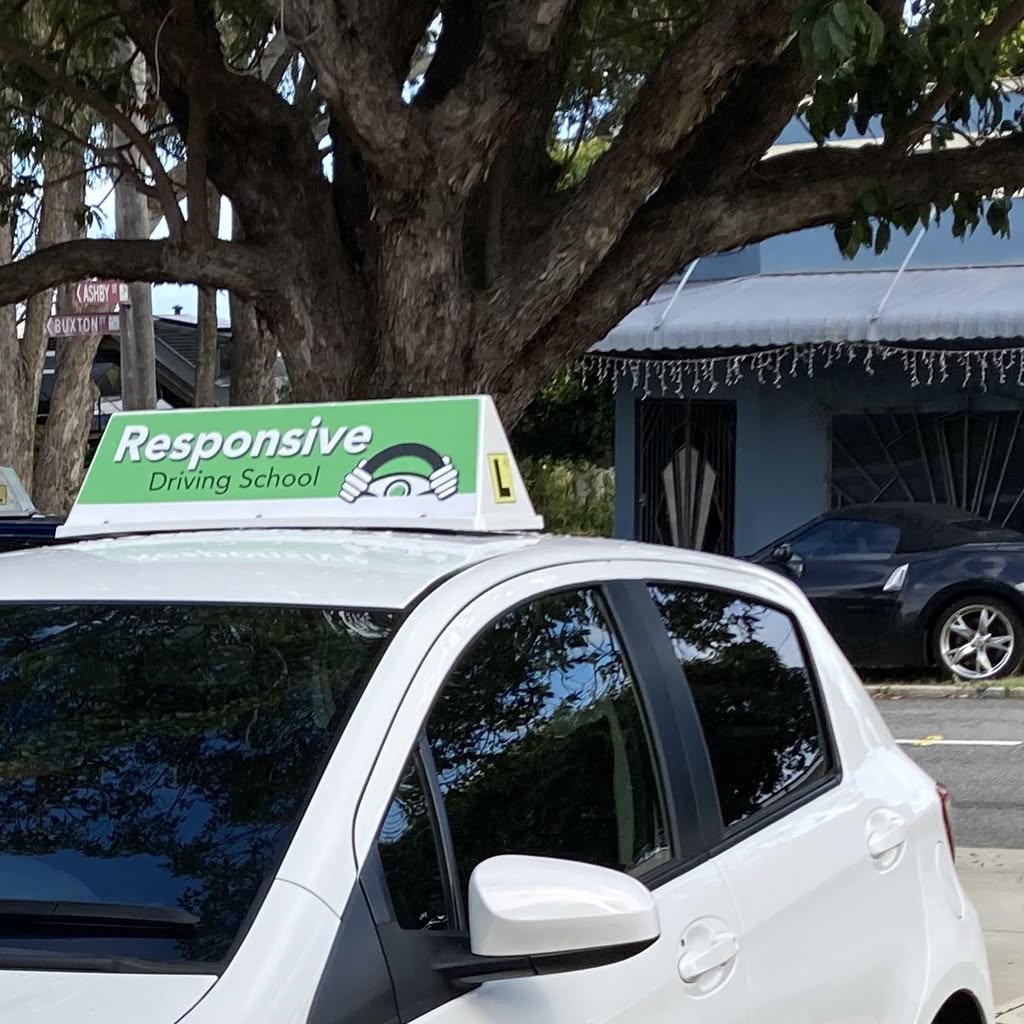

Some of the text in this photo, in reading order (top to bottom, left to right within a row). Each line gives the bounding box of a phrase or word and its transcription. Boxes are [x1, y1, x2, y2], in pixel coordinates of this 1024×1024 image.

[83, 283, 110, 303] ASHBY
[54, 316, 98, 334] BUXTON
[113, 415, 373, 470] Responsive
[148, 465, 321, 495] Driving School
[494, 457, 511, 498] L
